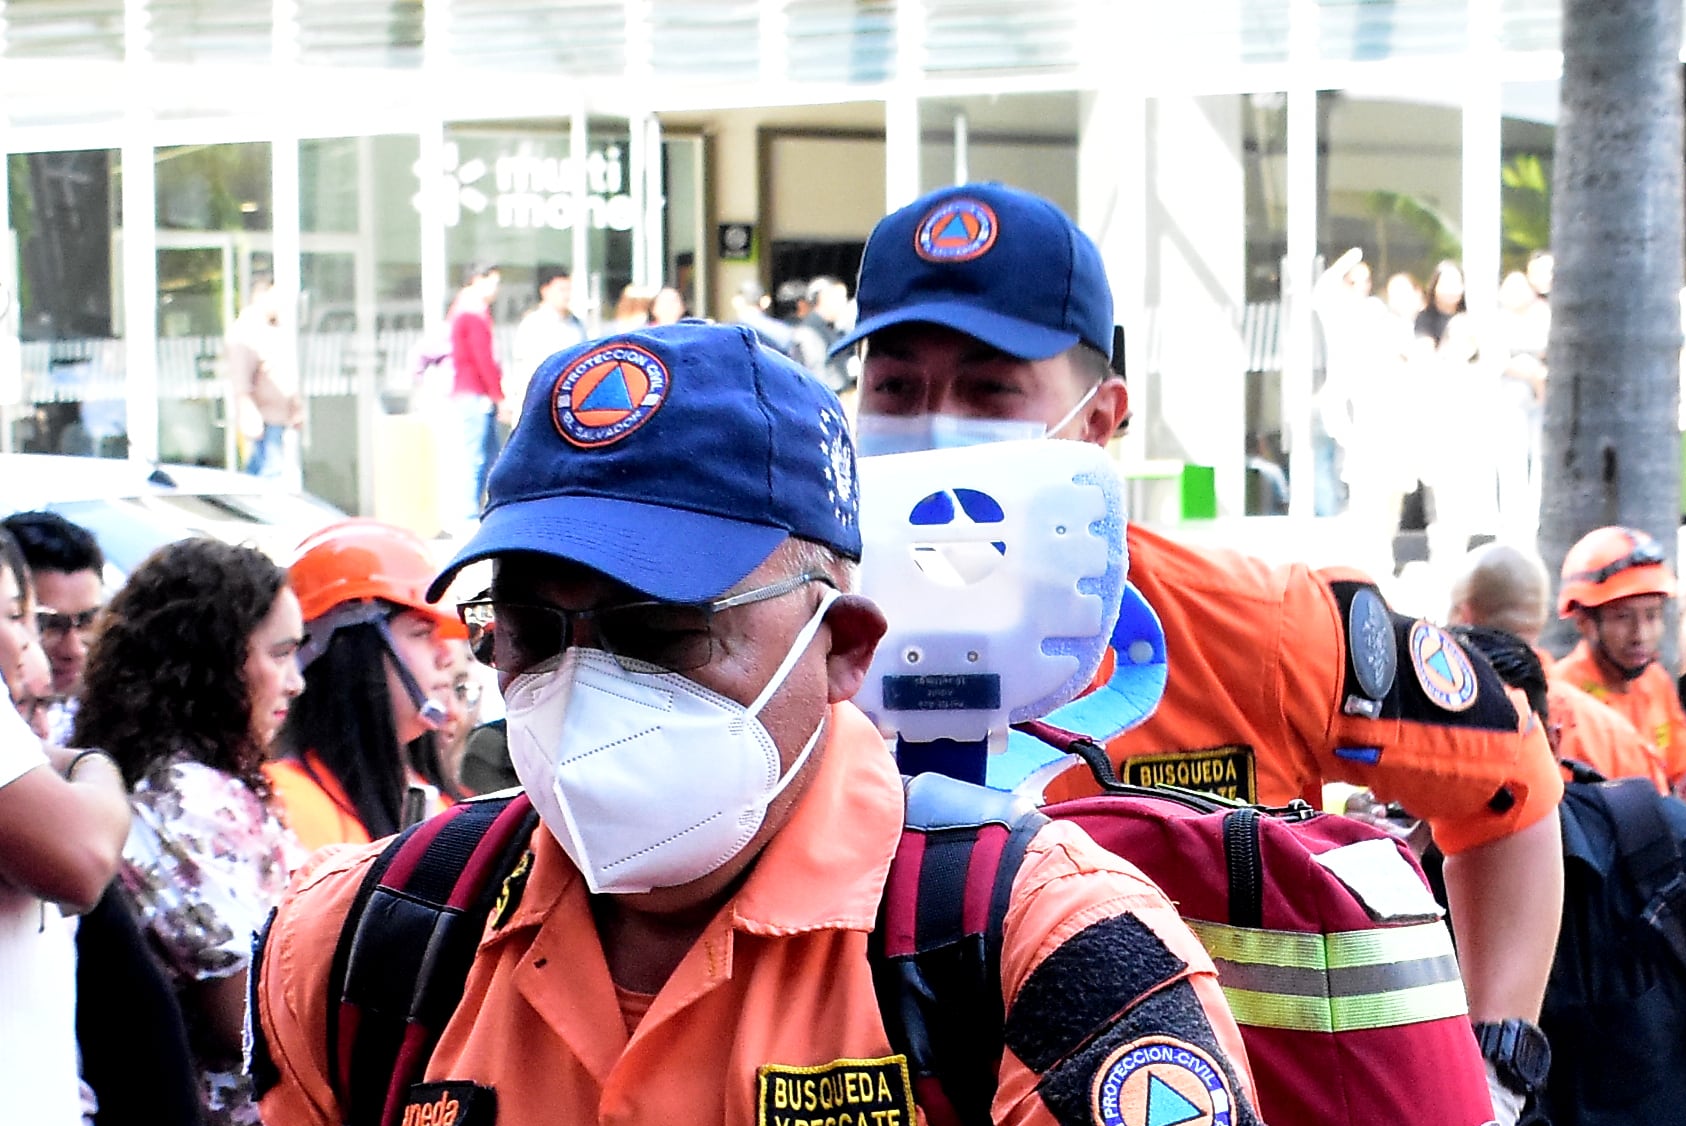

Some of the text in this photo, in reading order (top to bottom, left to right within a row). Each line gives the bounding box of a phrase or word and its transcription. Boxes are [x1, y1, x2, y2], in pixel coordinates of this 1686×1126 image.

[1140, 758, 1237, 788] BUSQUEDA
[774, 1072, 893, 1111] BUSQUEDA
[1103, 1048, 1214, 1118] PROTECCION CIVIL
